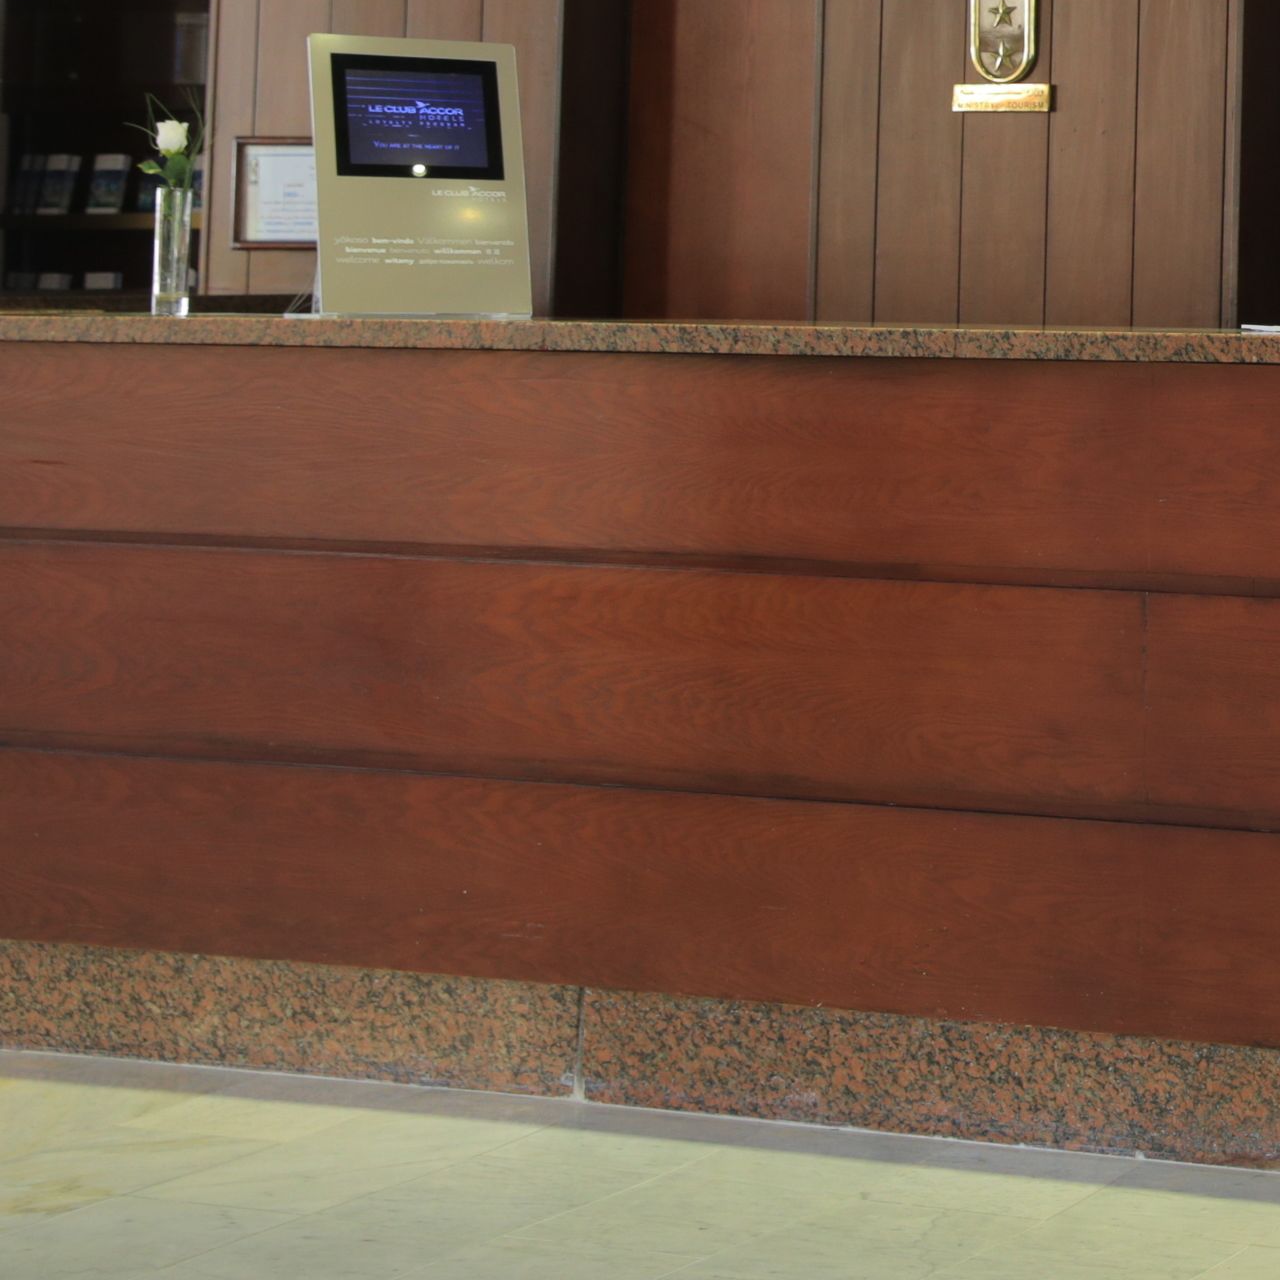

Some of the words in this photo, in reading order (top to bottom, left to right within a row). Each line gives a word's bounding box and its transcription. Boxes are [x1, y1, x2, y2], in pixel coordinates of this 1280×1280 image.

[368, 105, 383, 113] LE
[384, 106, 416, 114] CLUB
[419, 107, 464, 116] ACCOR
[471, 190, 506, 198] ACCOR
